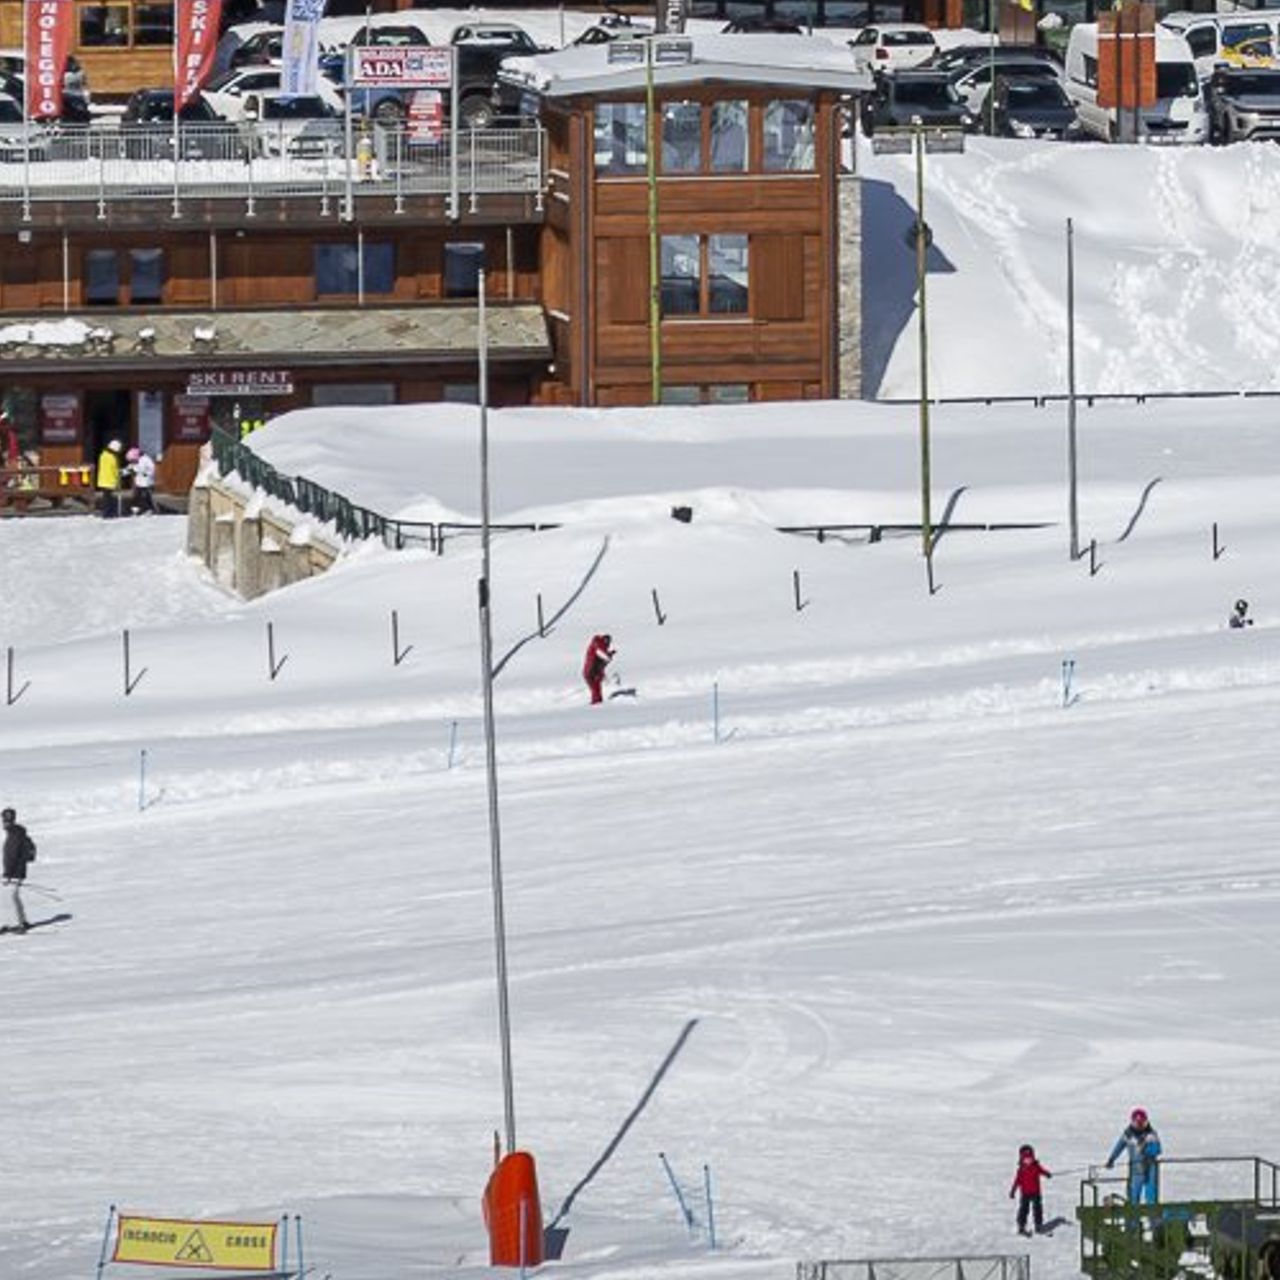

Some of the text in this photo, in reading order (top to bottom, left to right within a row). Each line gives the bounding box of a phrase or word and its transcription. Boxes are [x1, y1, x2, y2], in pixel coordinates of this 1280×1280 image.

[191, 0, 207, 45] SKI
[38, 1, 57, 112] NOLEGGIO
[361, 61, 401, 76] ADA
[190, 371, 291, 386] SKI RENT
